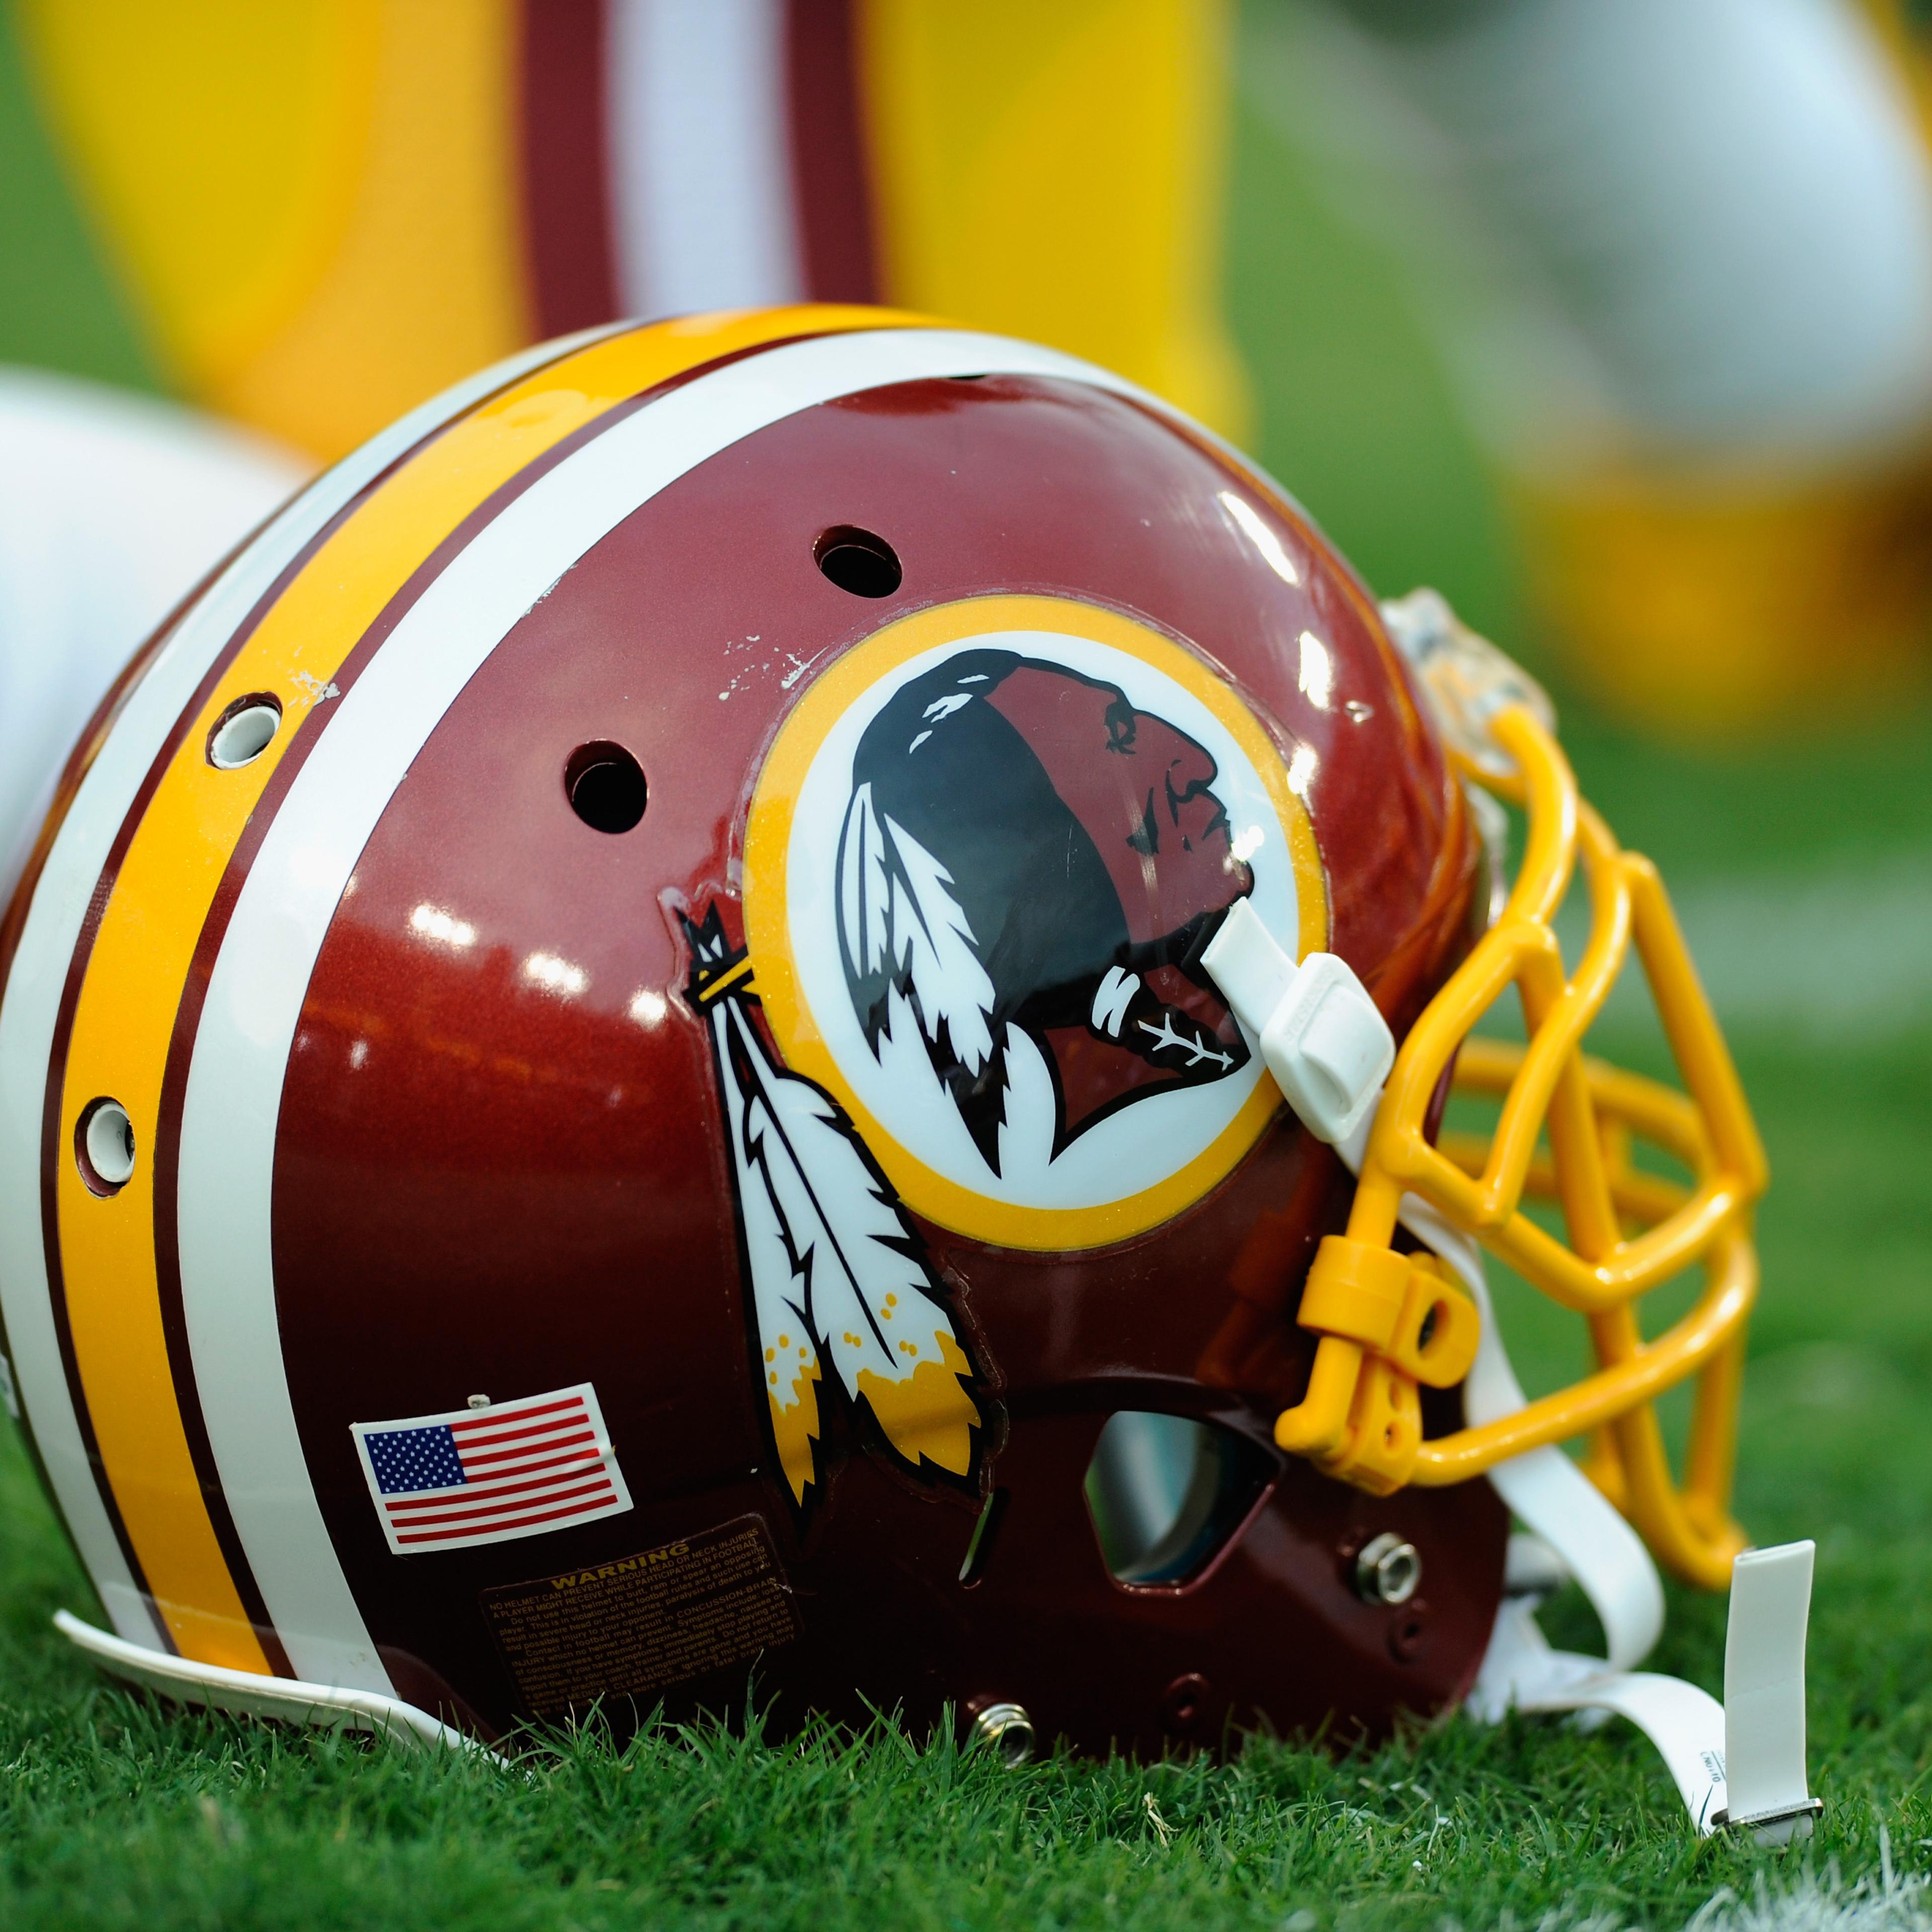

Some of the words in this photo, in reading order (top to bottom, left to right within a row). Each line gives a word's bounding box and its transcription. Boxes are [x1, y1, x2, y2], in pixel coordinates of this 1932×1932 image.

[501, 1606, 534, 1617] PLAYER
[536, 1600, 564, 1611] MIGHT
[566, 1591, 603, 1605] RECEIVE
[605, 1582, 633, 1595] WHILE
[635, 1560, 700, 1586] PARTICIPATING
[702, 1556, 711, 1564] IN
[505, 1596, 539, 1607] HELMET
[542, 1592, 561, 1601] CAN
[564, 1581, 605, 1596] PREVENT
[607, 1569, 647, 1585] SERIOUS
[649, 1560, 674, 1573] HEAD
[676, 1554, 690, 1564] OR
[692, 1545, 716, 1558] NECK
[719, 1528, 759, 1549] INJURIES
[552, 1543, 690, 1589] WARNING
[572, 1608, 608, 1621] violation
[636, 1589, 669, 1604] football
[671, 1582, 692, 1593] rules
[695, 1574, 710, 1585] and
[713, 1566, 733, 1578] such
[736, 1561, 751, 1570] use
[753, 1554, 768, 1563] can
[582, 1597, 612, 1610] helmet
[651, 1582, 667, 1591] ram
[683, 1568, 707, 1580] spear
[724, 1546, 765, 1565] opposing
[503, 1634, 526, 1643] result
[540, 1628, 568, 1637] severe
[570, 1621, 591, 1631] head
[606, 1611, 626, 1622] neck
[666, 1587, 705, 1605] paralysis
[718, 1572, 742, 1585] death
[755, 1562, 771, 1573] you
[512, 1656, 545, 1666] INJURY
[548, 1650, 573, 1661] which
[589, 1640, 618, 1652] helmet
[678, 1607, 723, 1626] Symptoms
[524, 1637, 560, 1649] possible
[562, 1632, 588, 1641] injury
[601, 1624, 619, 1633] your
[526, 1645, 560, 1656] Contact
[576, 1633, 610, 1647] football
[614, 1629, 632, 1637] may
[636, 1618, 662, 1631] result
